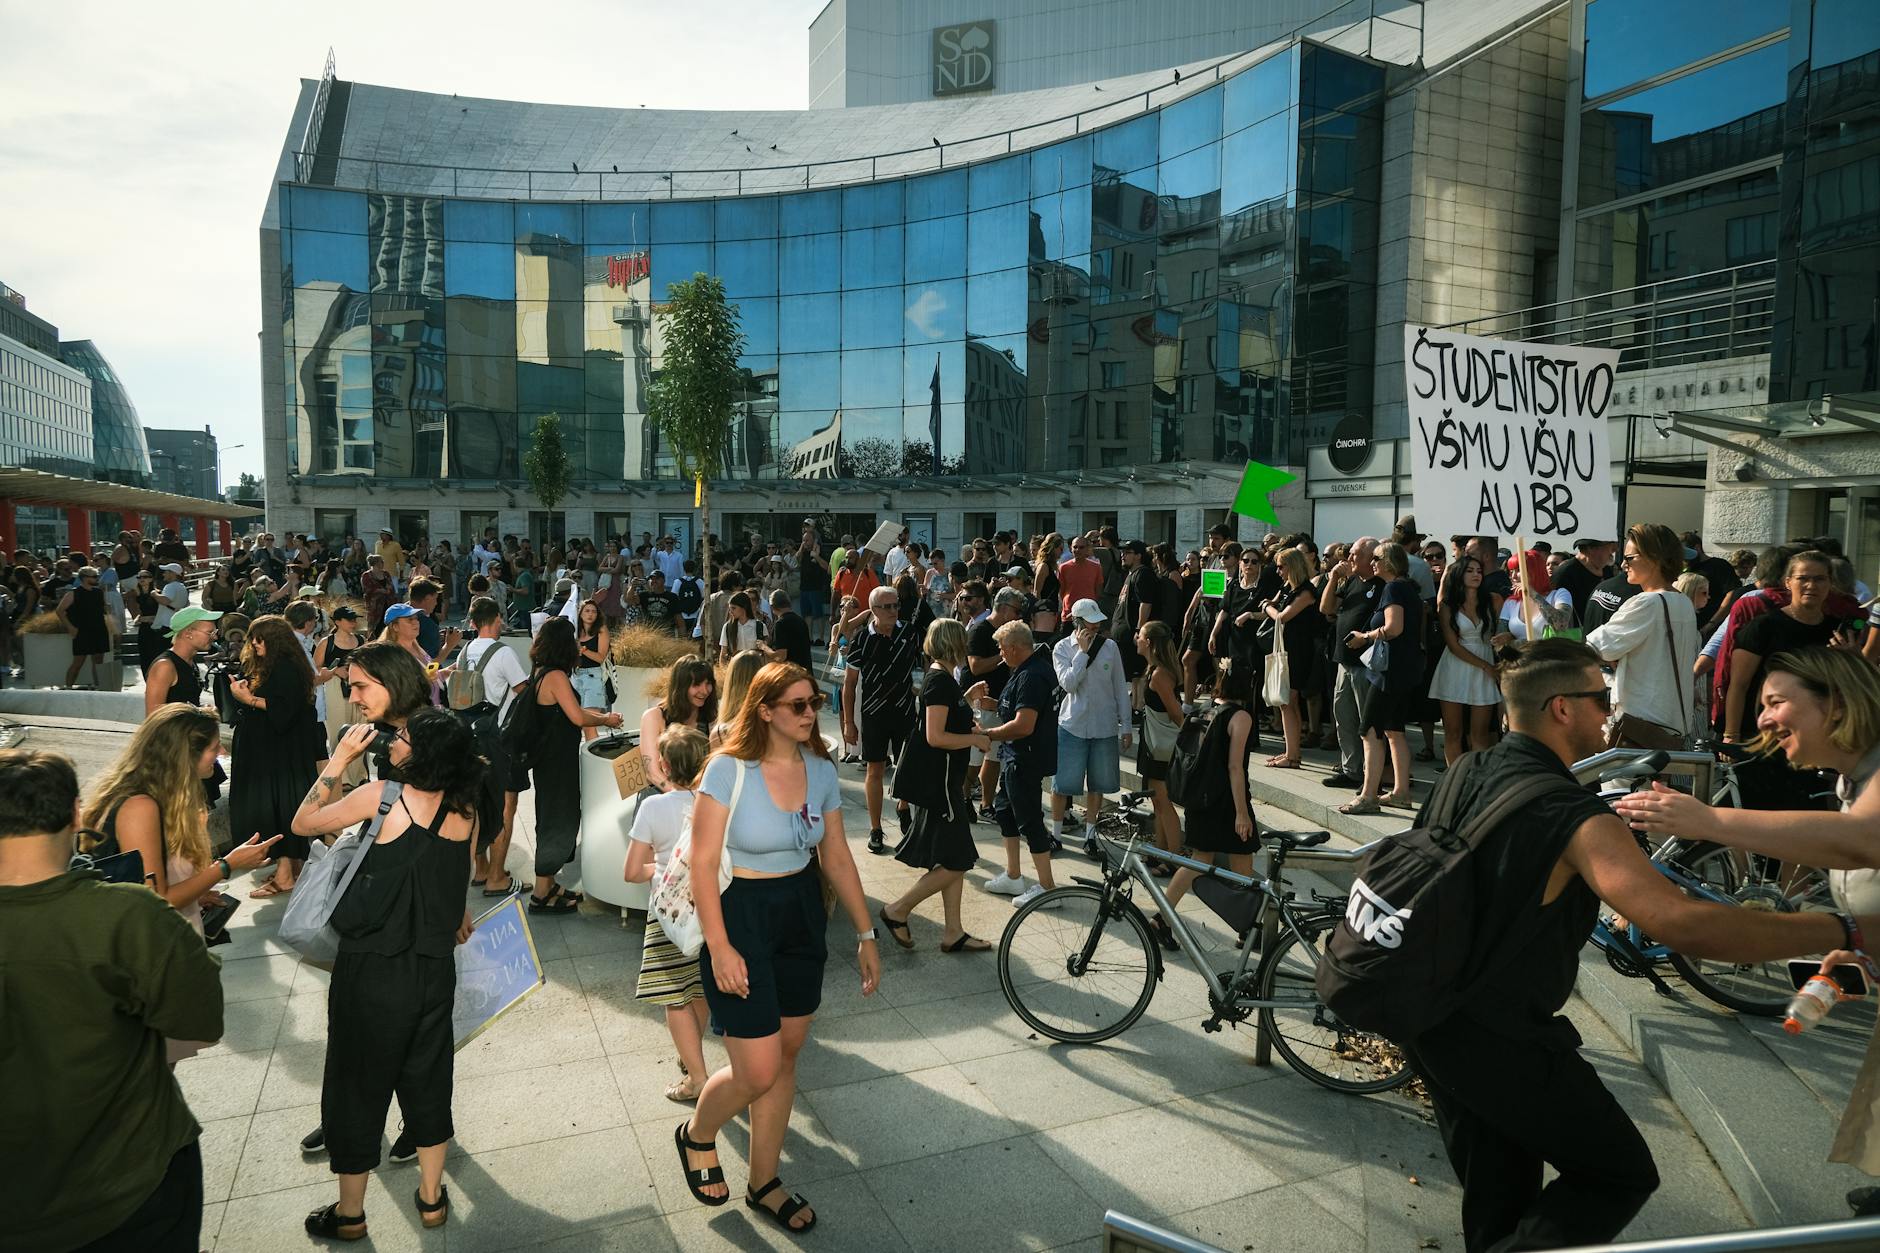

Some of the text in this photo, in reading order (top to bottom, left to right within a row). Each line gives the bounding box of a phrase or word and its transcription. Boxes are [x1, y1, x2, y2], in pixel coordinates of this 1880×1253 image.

[1412, 327, 1614, 419] ŠTUDENTSTVO
[1655, 376, 1767, 400] DIVADLO
[1335, 438, 1367, 449] ČINOHRA
[1418, 407, 1595, 482] VŠMU VŠVU
[1330, 481, 1367, 493] SLOVENSKÉ
[1475, 479, 1579, 536] AU BB
